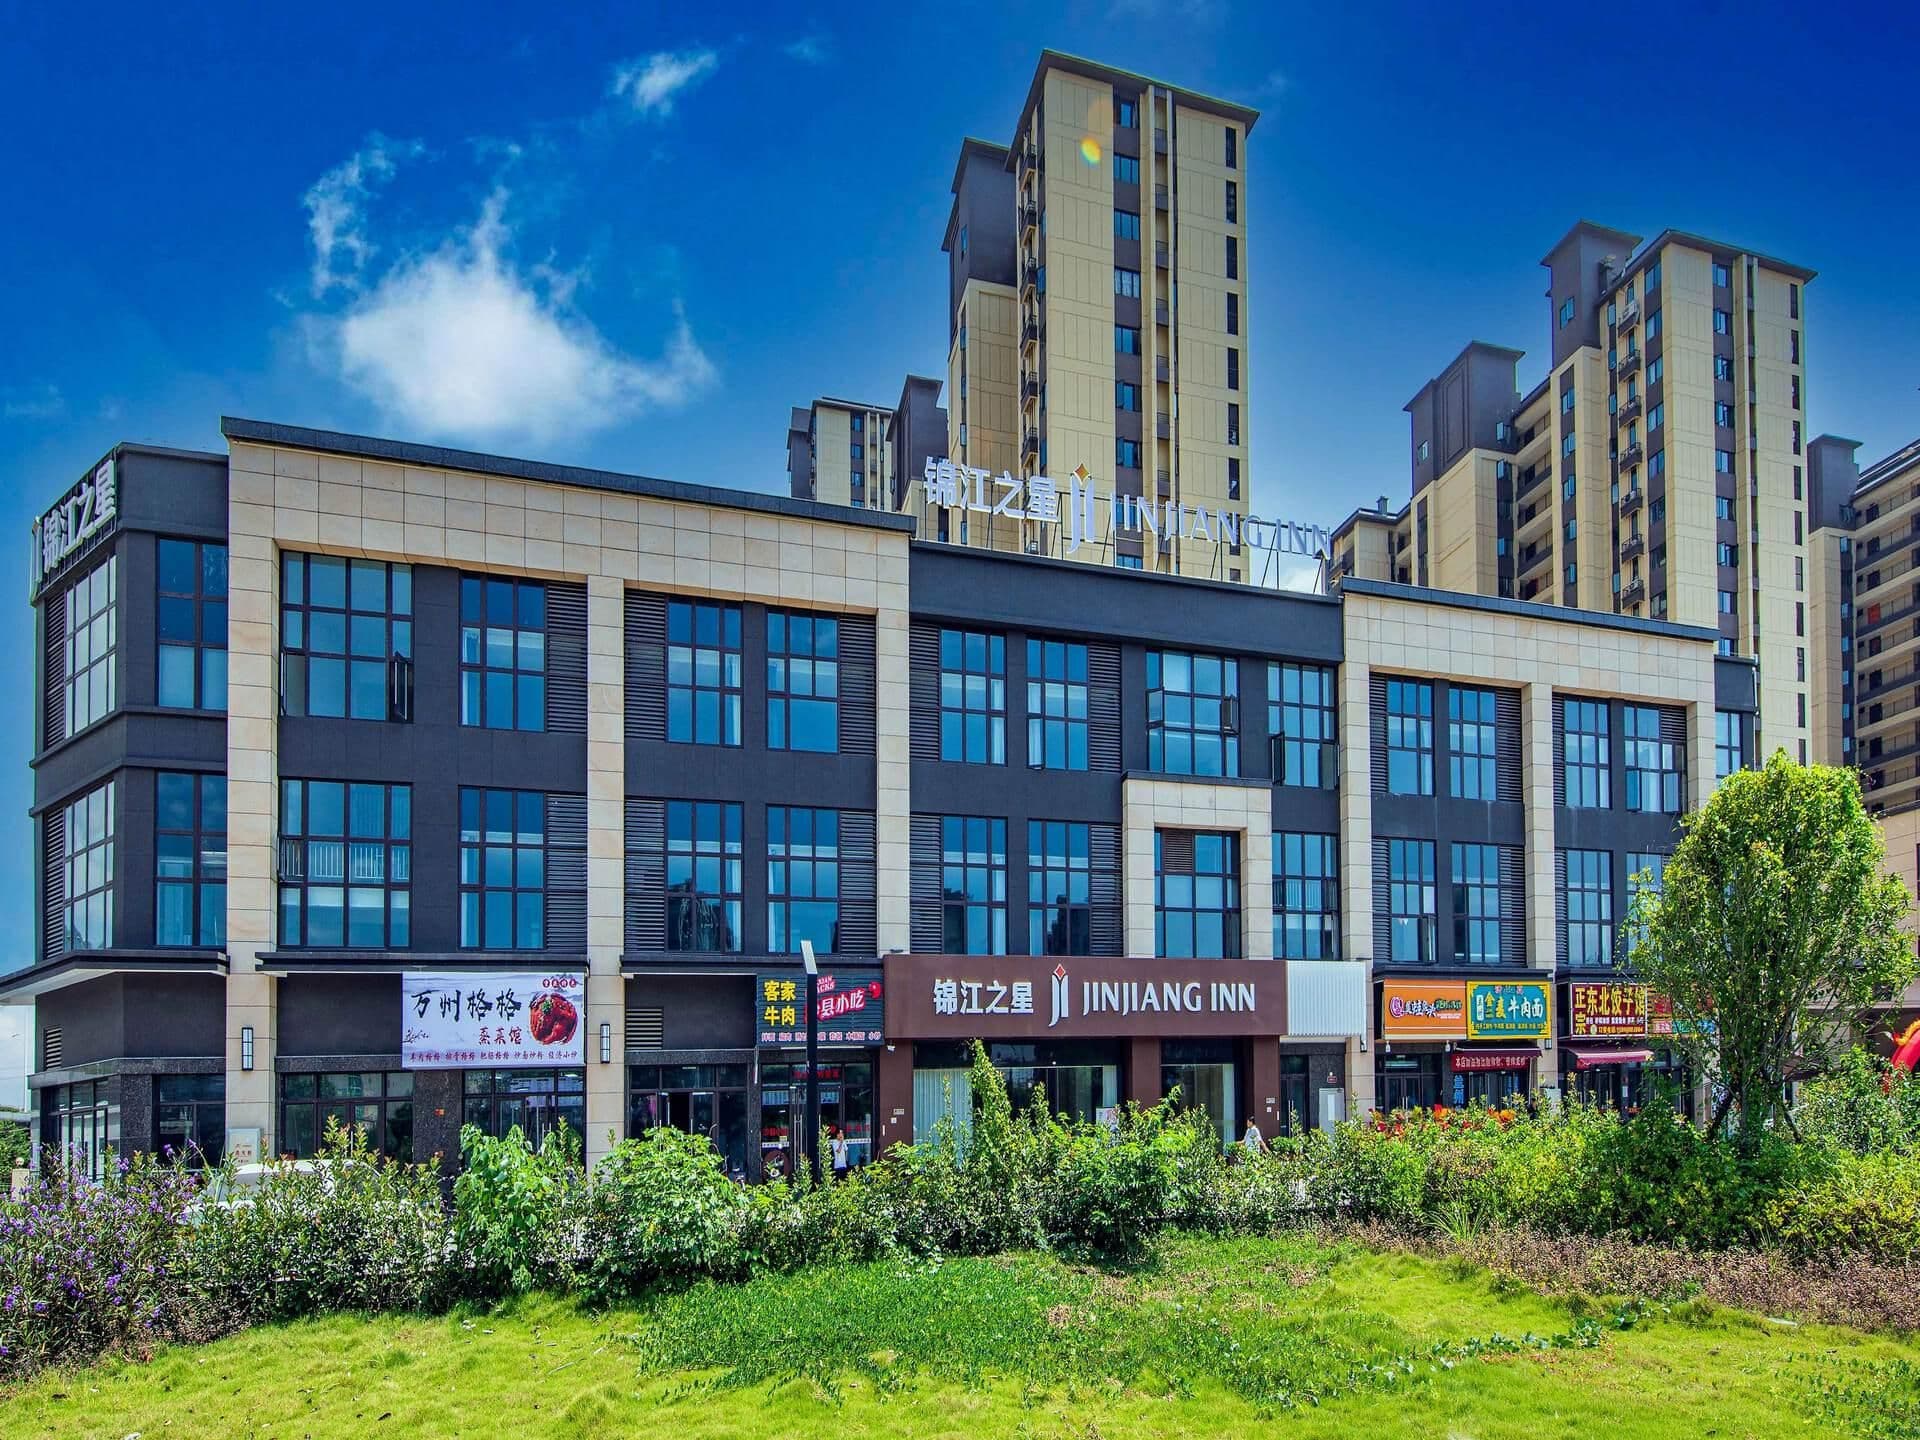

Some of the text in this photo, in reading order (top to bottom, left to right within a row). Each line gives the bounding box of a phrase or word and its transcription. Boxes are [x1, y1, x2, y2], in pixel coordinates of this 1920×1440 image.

[924, 456, 1059, 523] 锦江之星
[43, 460, 116, 573] 锦江之星
[1108, 493, 1331, 560] JINJIANG INN
[411, 988, 522, 1023] 万州格格
[763, 980, 796, 1002] 客家
[817, 989, 865, 1018] 县小吃
[933, 979, 1034, 1015] 锦江之星
[1083, 982, 1257, 1017] JINJIANG INN
[763, 1005, 796, 1027] 牛肉
[478, 1026, 523, 1046] 蒸菜馆
